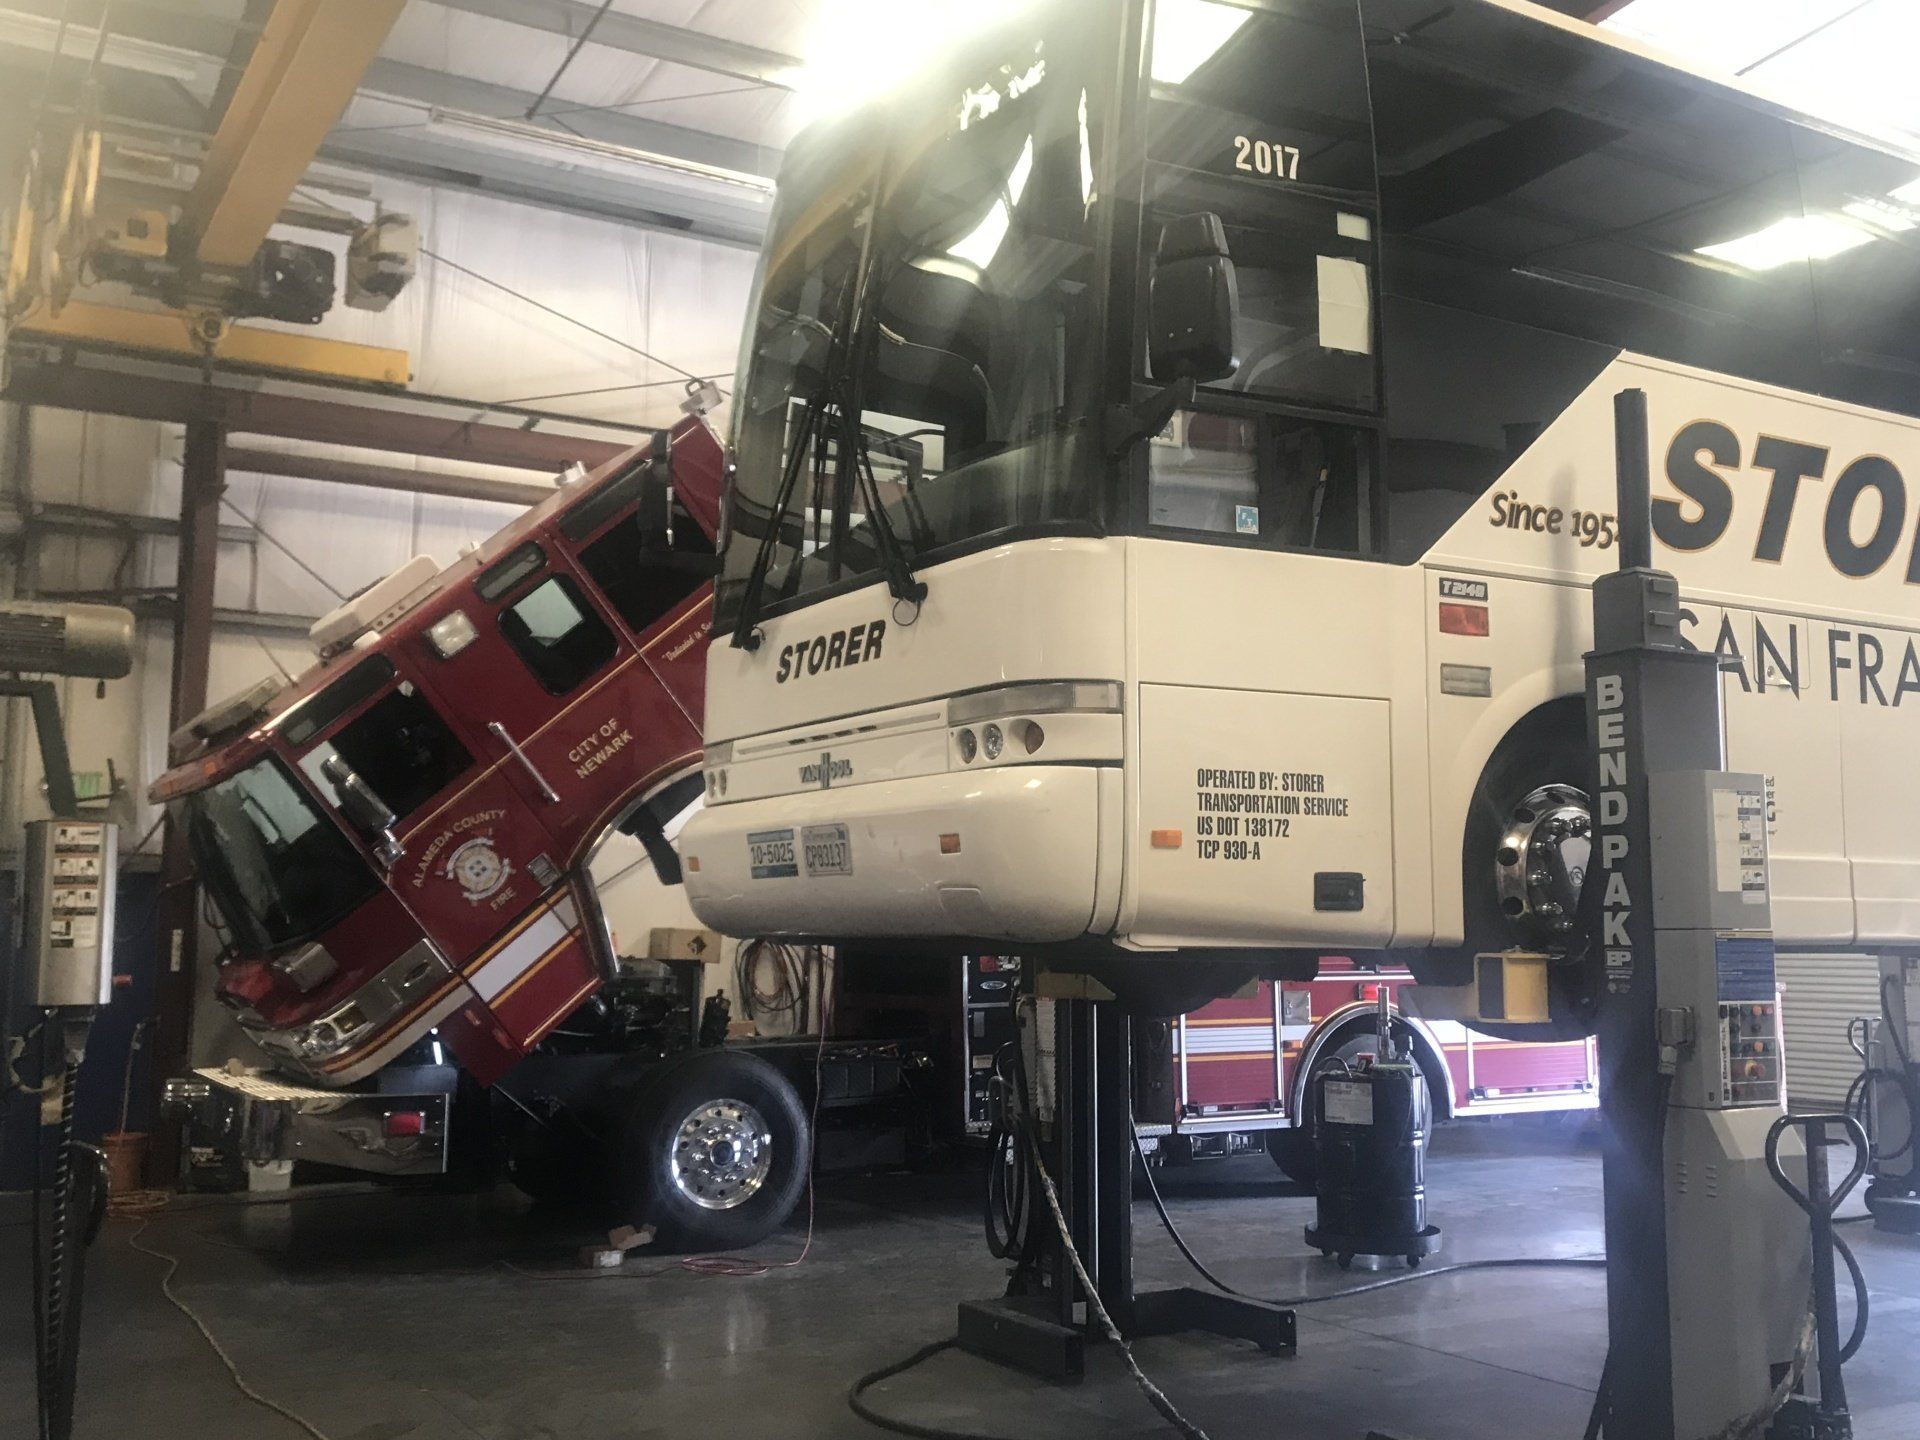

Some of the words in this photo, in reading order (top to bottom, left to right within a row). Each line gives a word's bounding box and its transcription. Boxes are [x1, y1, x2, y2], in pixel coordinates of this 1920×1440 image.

[1234, 136, 1299, 180] 2017
[1489, 490, 1563, 534] Since
[1570, 510, 1619, 549] 195
[1651, 418, 1920, 586] STO
[776, 619, 886, 684] STORER
[568, 733, 598, 762] CITY
[600, 718, 617, 737] OF
[576, 730, 633, 779] NEWARK
[1197, 768, 1255, 790] OPERATED
[1259, 771, 1278, 791] BY:
[1282, 773, 1324, 793] STORER
[1197, 792, 1300, 815] TRANSPORTATION
[1304, 797, 1348, 817] SERVICE
[1596, 675, 1632, 946] BENDPAK
[412, 830, 453, 888] ALAMEDA
[453, 809, 506, 833] COUNTY
[1197, 816, 1213, 836] US
[1217, 817, 1240, 836] DOT
[1244, 818, 1290, 838] 138172
[1197, 840, 1220, 859] TCP
[1223, 841, 1261, 860] 930-A
[490, 886, 516, 911] FIRE
